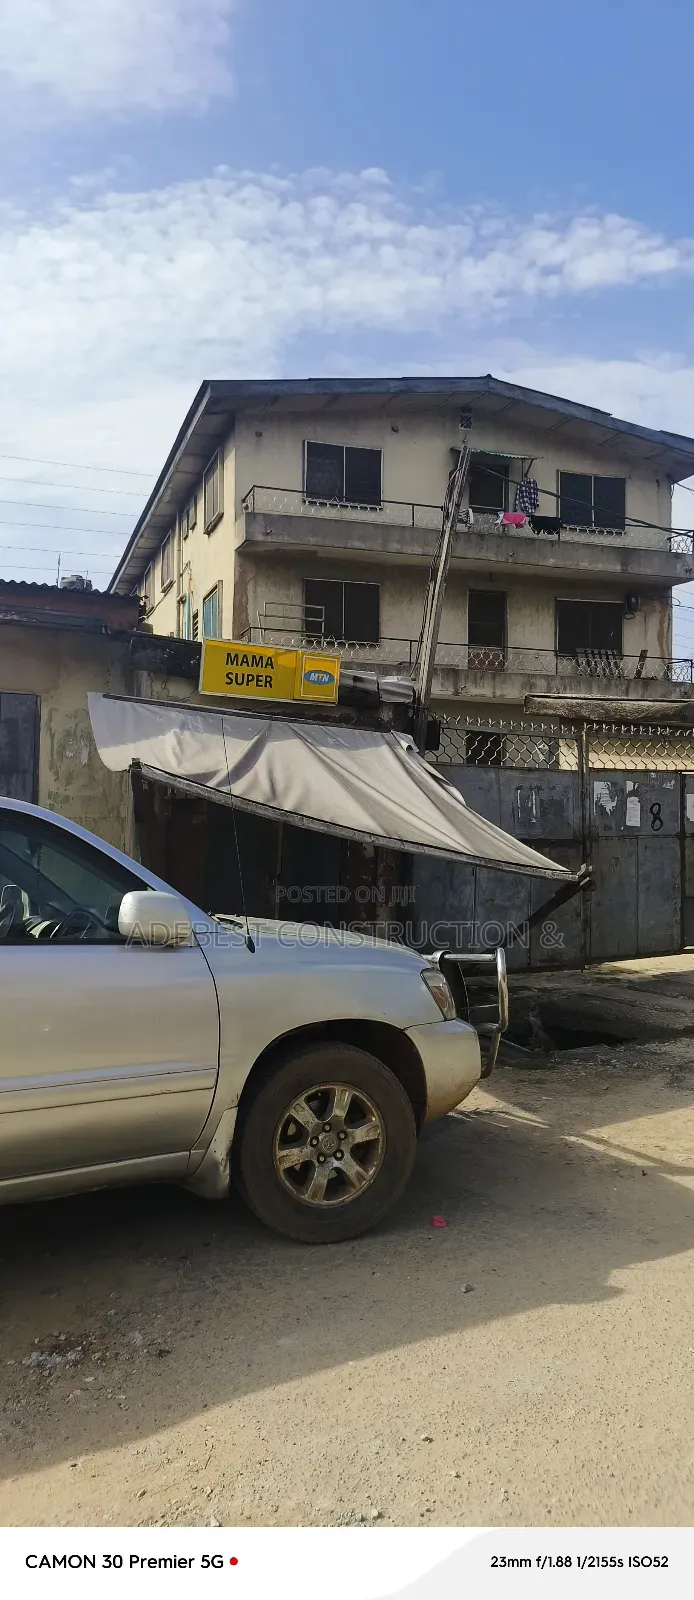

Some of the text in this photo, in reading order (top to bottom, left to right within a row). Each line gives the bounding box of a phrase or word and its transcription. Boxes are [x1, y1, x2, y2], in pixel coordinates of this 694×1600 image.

[225, 652, 274, 669] MAMA
[225, 671, 273, 688] SUPER
[309, 672, 330, 682] MTN
[650, 802, 664, 831] 8
